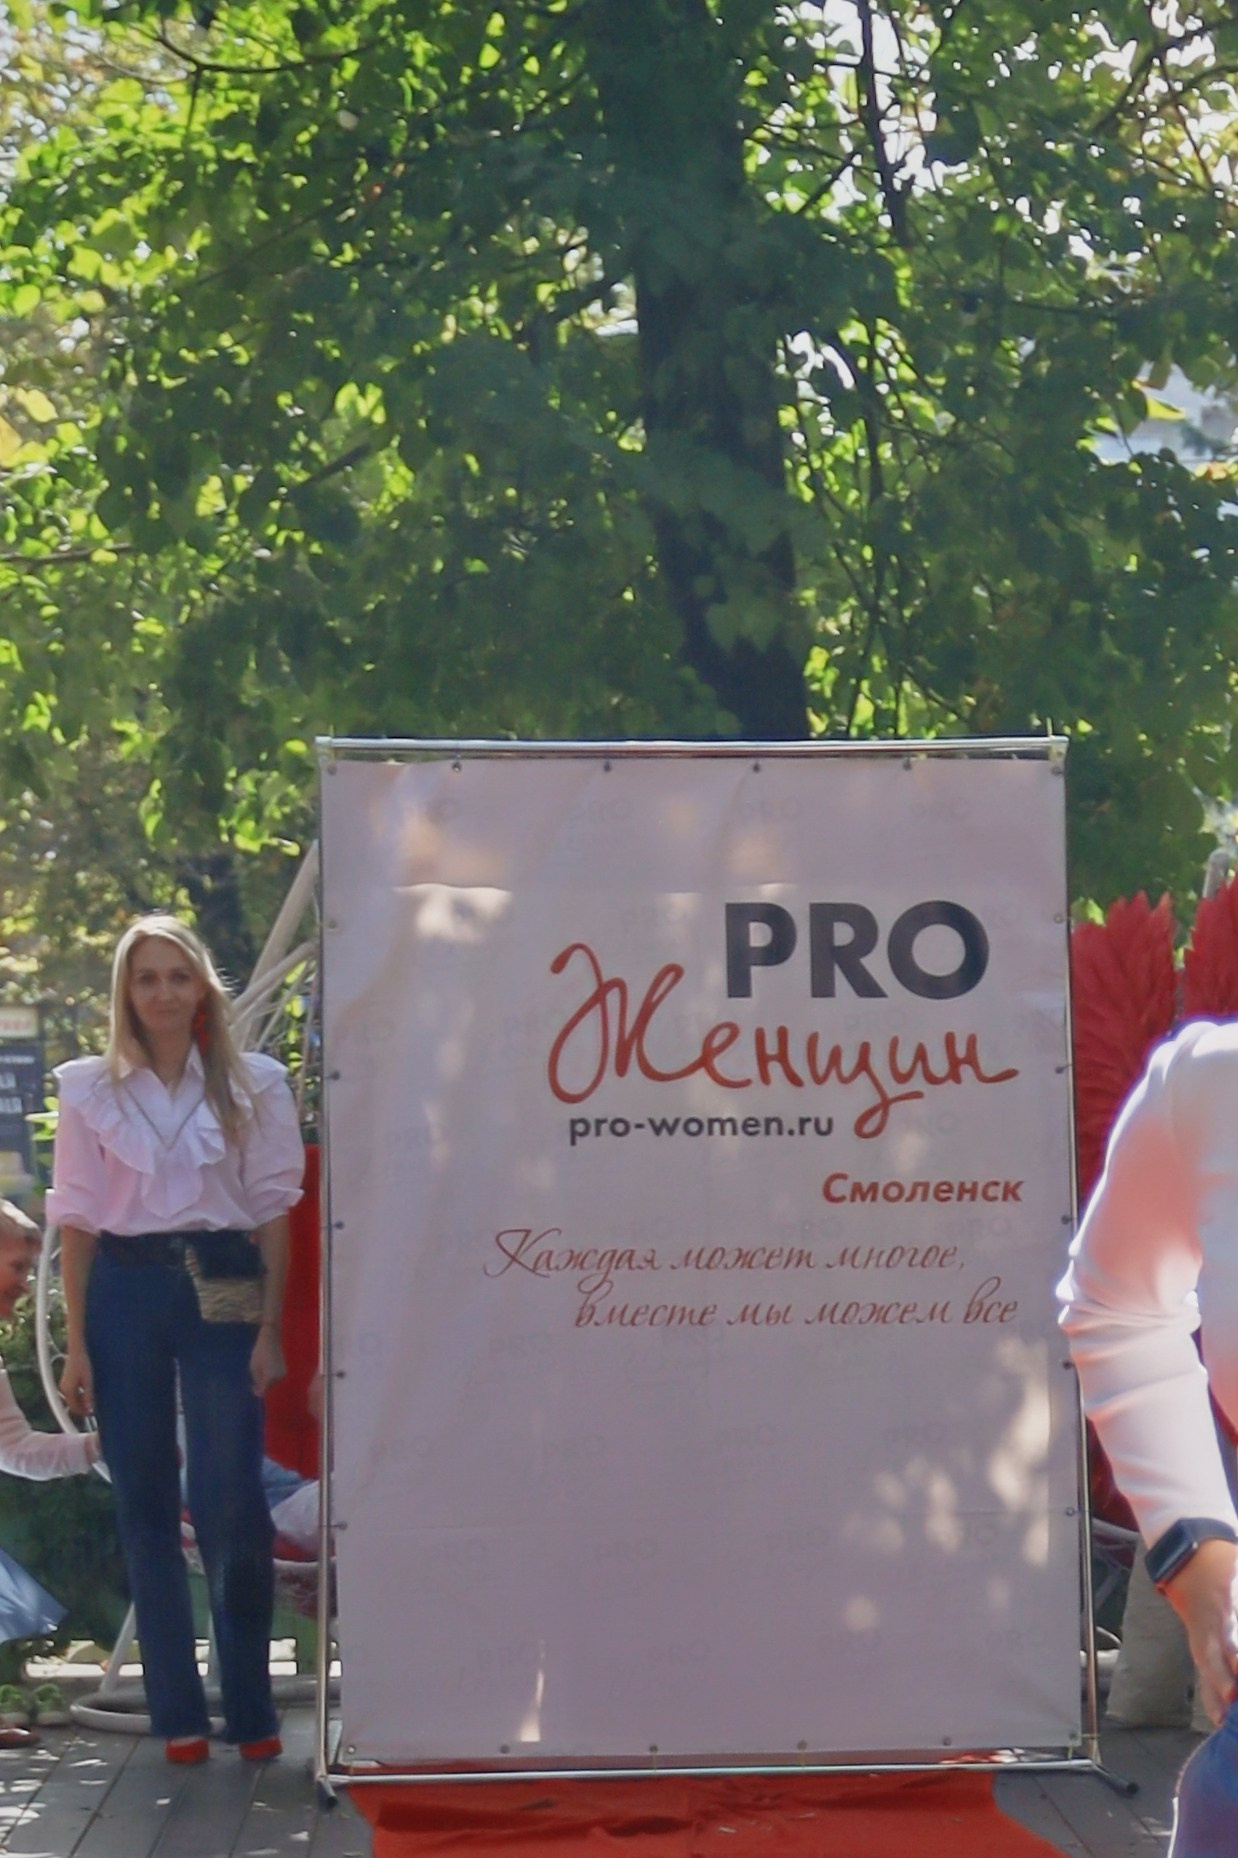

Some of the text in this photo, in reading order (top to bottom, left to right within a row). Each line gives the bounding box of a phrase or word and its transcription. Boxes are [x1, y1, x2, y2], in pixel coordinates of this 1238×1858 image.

[725, 900, 990, 1000] PRO
[547, 942, 1020, 1140] Женщин
[569, 1116, 834, 1147] pro-women.ru
[822, 1172, 1025, 1204] Смоленск
[484, 1228, 966, 1294] Каждая может многое,
[575, 1276, 1019, 1328] вместе мы можем все
